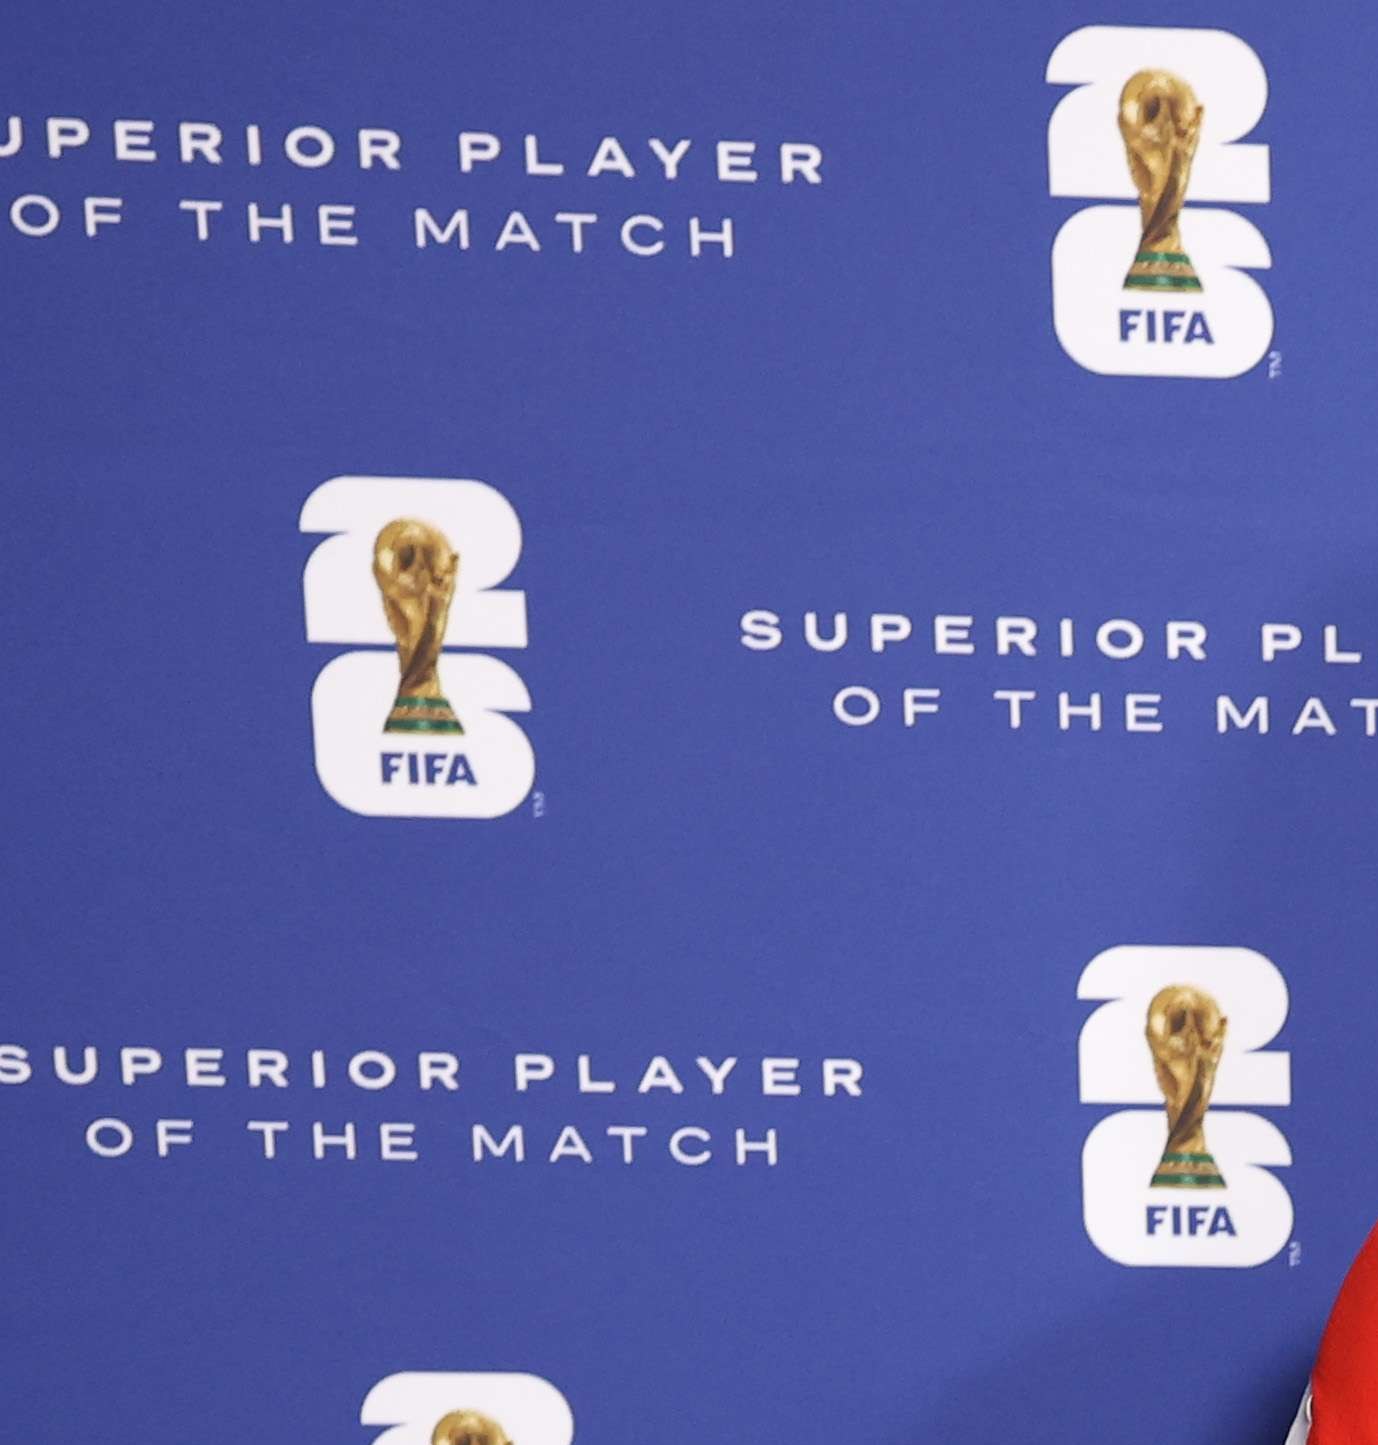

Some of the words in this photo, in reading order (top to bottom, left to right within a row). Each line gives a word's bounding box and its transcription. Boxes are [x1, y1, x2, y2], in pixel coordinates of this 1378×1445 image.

[458, 131, 823, 185] PLAYER
[9, 194, 123, 238] OF
[178, 199, 359, 247] THE
[414, 207, 734, 258] MATCH
[1119, 309, 1214, 345] FIFA
[740, 609, 1208, 661] SUPERIOR
[832, 685, 941, 727] OF
[993, 689, 1164, 733] THE
[380, 752, 478, 786] FIFA
[0, 1044, 459, 1091] SUPERIOR
[514, 1053, 863, 1097] PLAYER
[85, 1117, 194, 1158] OF
[246, 1120, 419, 1162] THE
[472, 1123, 778, 1166] MATCH
[1146, 1205, 1237, 1237] FIFA
